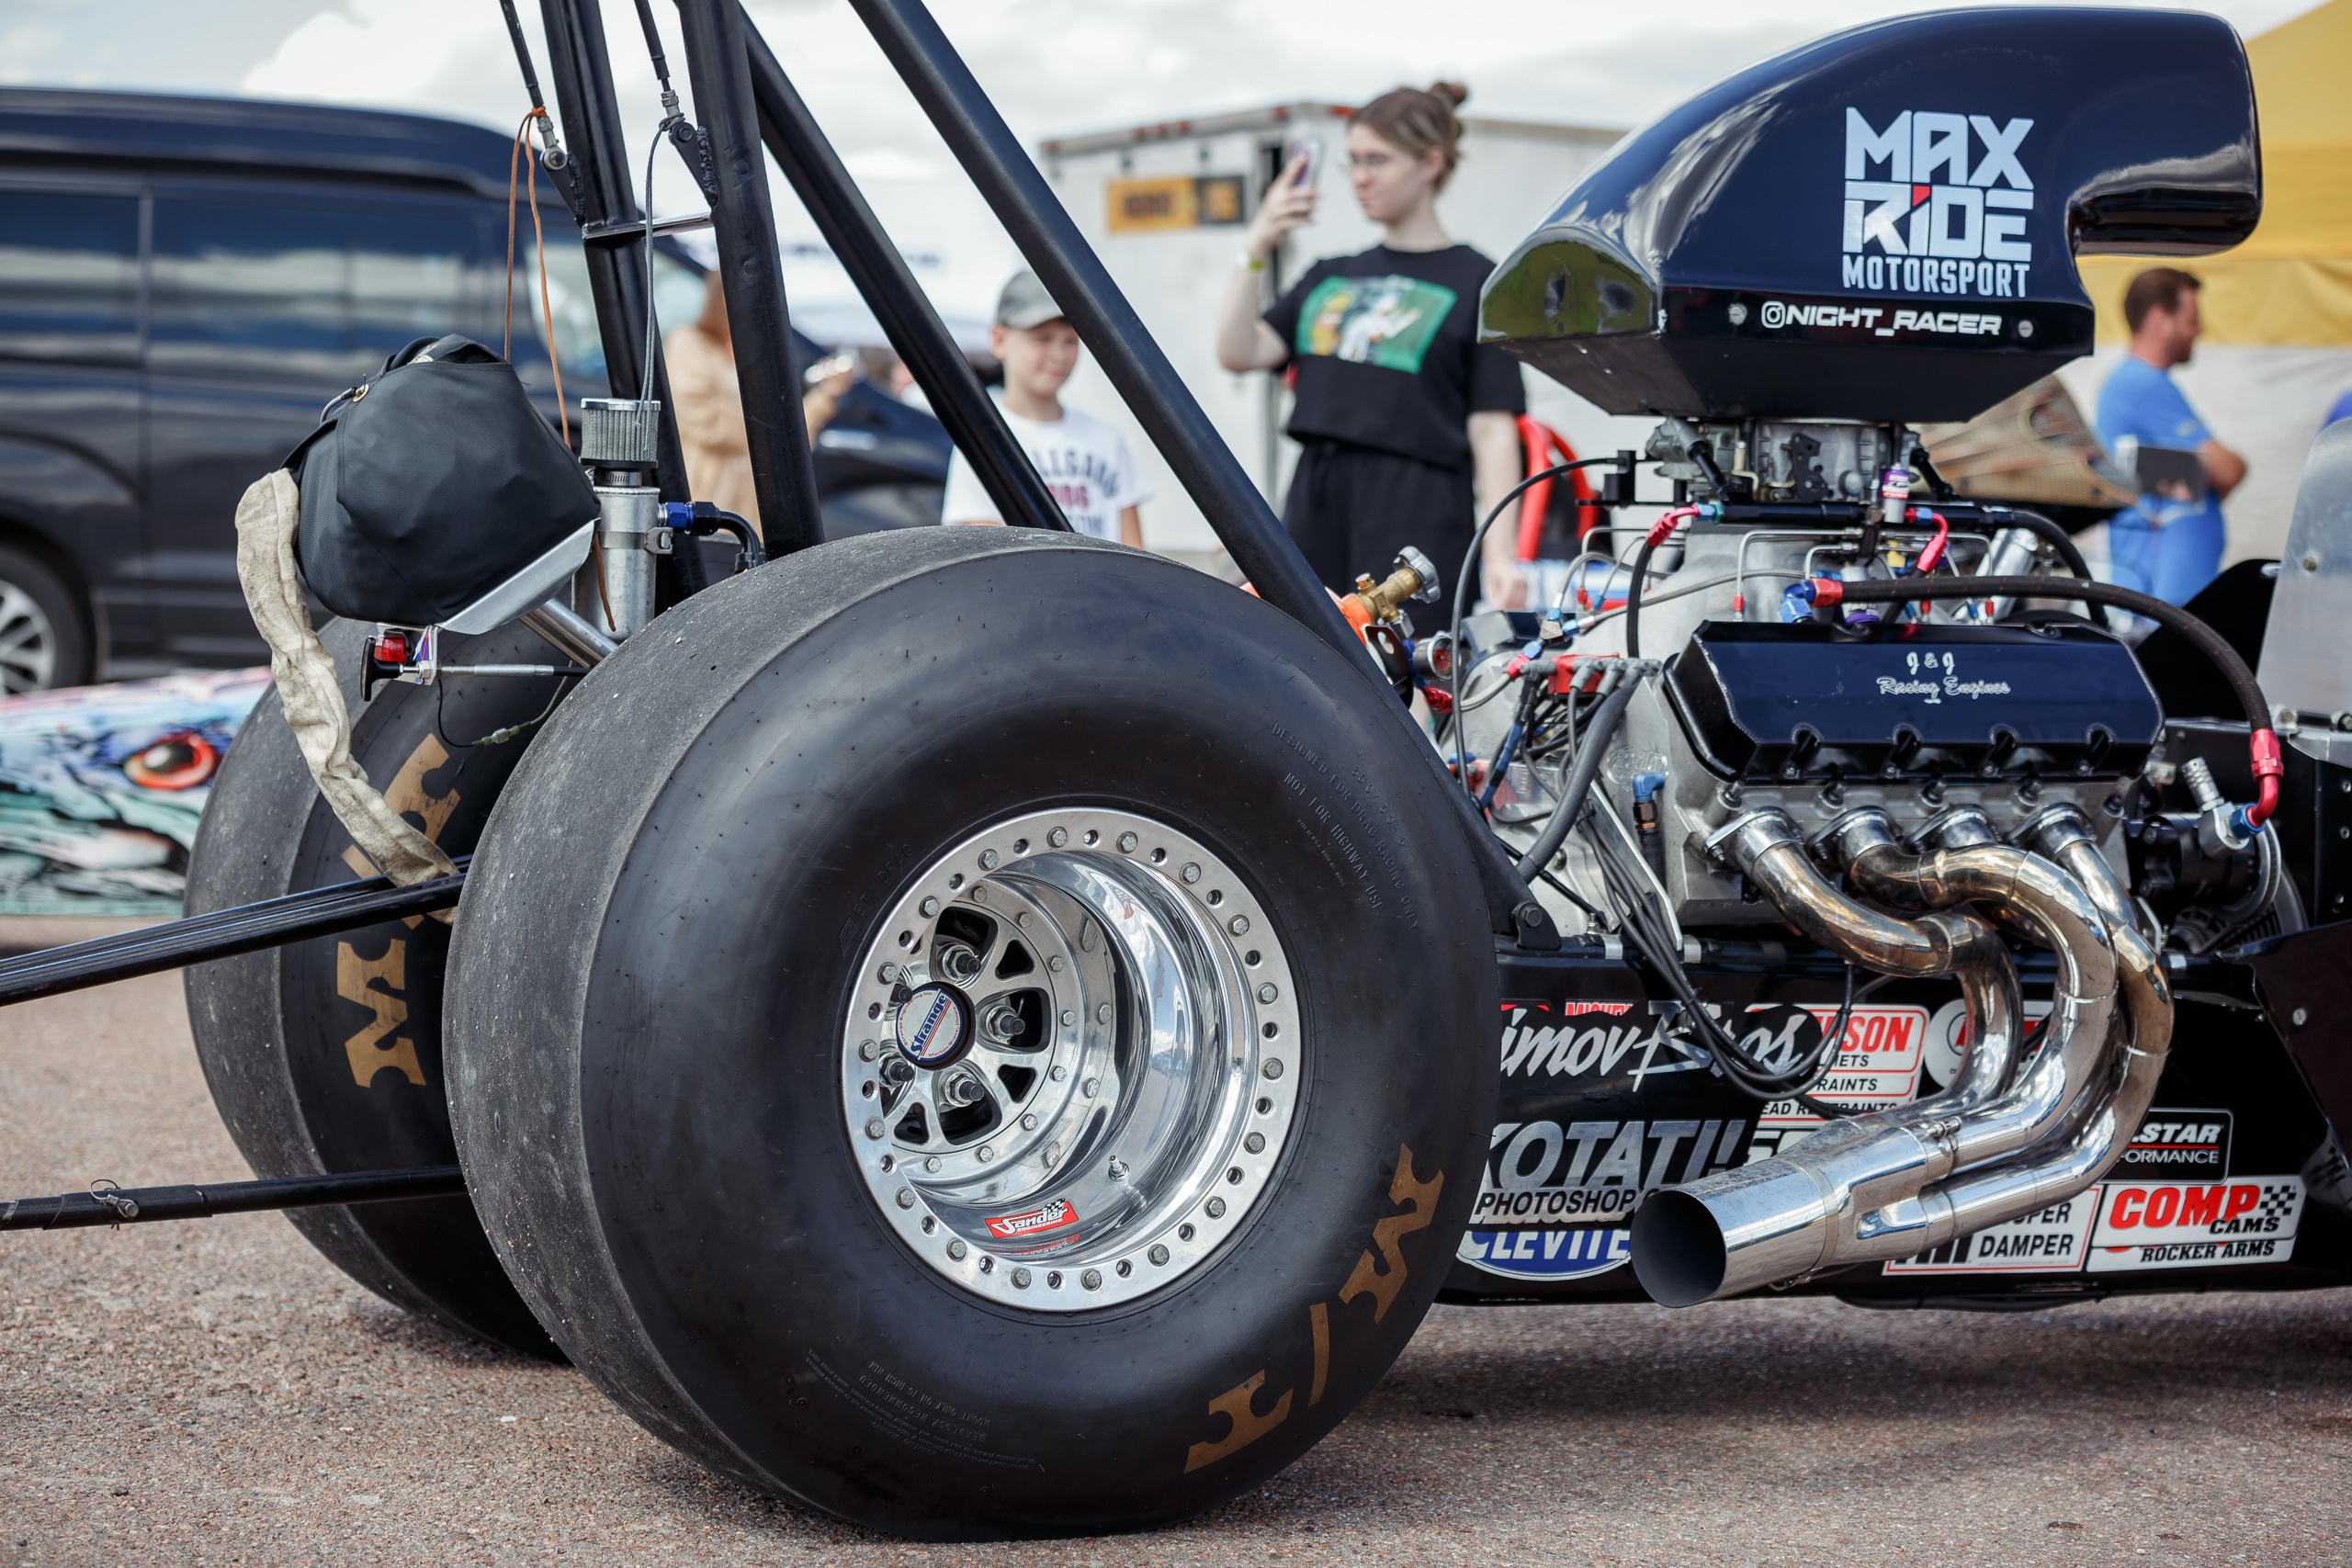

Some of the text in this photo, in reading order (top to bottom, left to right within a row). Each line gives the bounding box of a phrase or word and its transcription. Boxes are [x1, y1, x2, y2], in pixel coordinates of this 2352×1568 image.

[1845, 107, 2034, 189] MAX
[1842, 254, 2030, 298] MOTORSPORT
[1906, 651, 1956, 675] J & J
[1876, 675, 2011, 699] Racing Engines
[1272, 722, 1419, 931] DESIGNED FOR DRAG RACING ONLY
[1283, 772, 1309, 797] NOT
[1308, 796, 1332, 825] FOR
[1329, 823, 1370, 881] HIGHWAY
[1364, 884, 1385, 910] USE
[853, 843, 912, 918] ET DRAG
[899, 1021, 909, 1046] Strange
[910, 995, 947, 1053] Strange
[928, 1046, 949, 1057] Morton
[1500, 1007, 1643, 1077] imov
[1818, 1078, 1878, 1091] RAINTS
[1760, 1102, 1792, 1115] EAD
[2134, 1122, 2221, 1144] STAR
[2120, 1149, 2220, 1164] ORMANCE
[1475, 1189, 1637, 1216] PHOTOSHOP
[2109, 1184, 2260, 1229] COMP
[991, 1208, 1069, 1235] Sander
[1016, 1218, 1063, 1232] ENGINEERING
[2209, 1217, 2280, 1235] CAMS
[1978, 1234, 2074, 1258] DAMPER
[2141, 1240, 2277, 1263] ROCKER ARMS
[868, 1360, 886, 1376] RIM
[858, 1374, 930, 1422] RECOMMENDED
[907, 1387, 918, 1399] 16
[934, 1402, 956, 1418] ONLY
[960, 1409, 991, 1427] MOUNT
[932, 1416, 987, 1443] BEADLOCK
